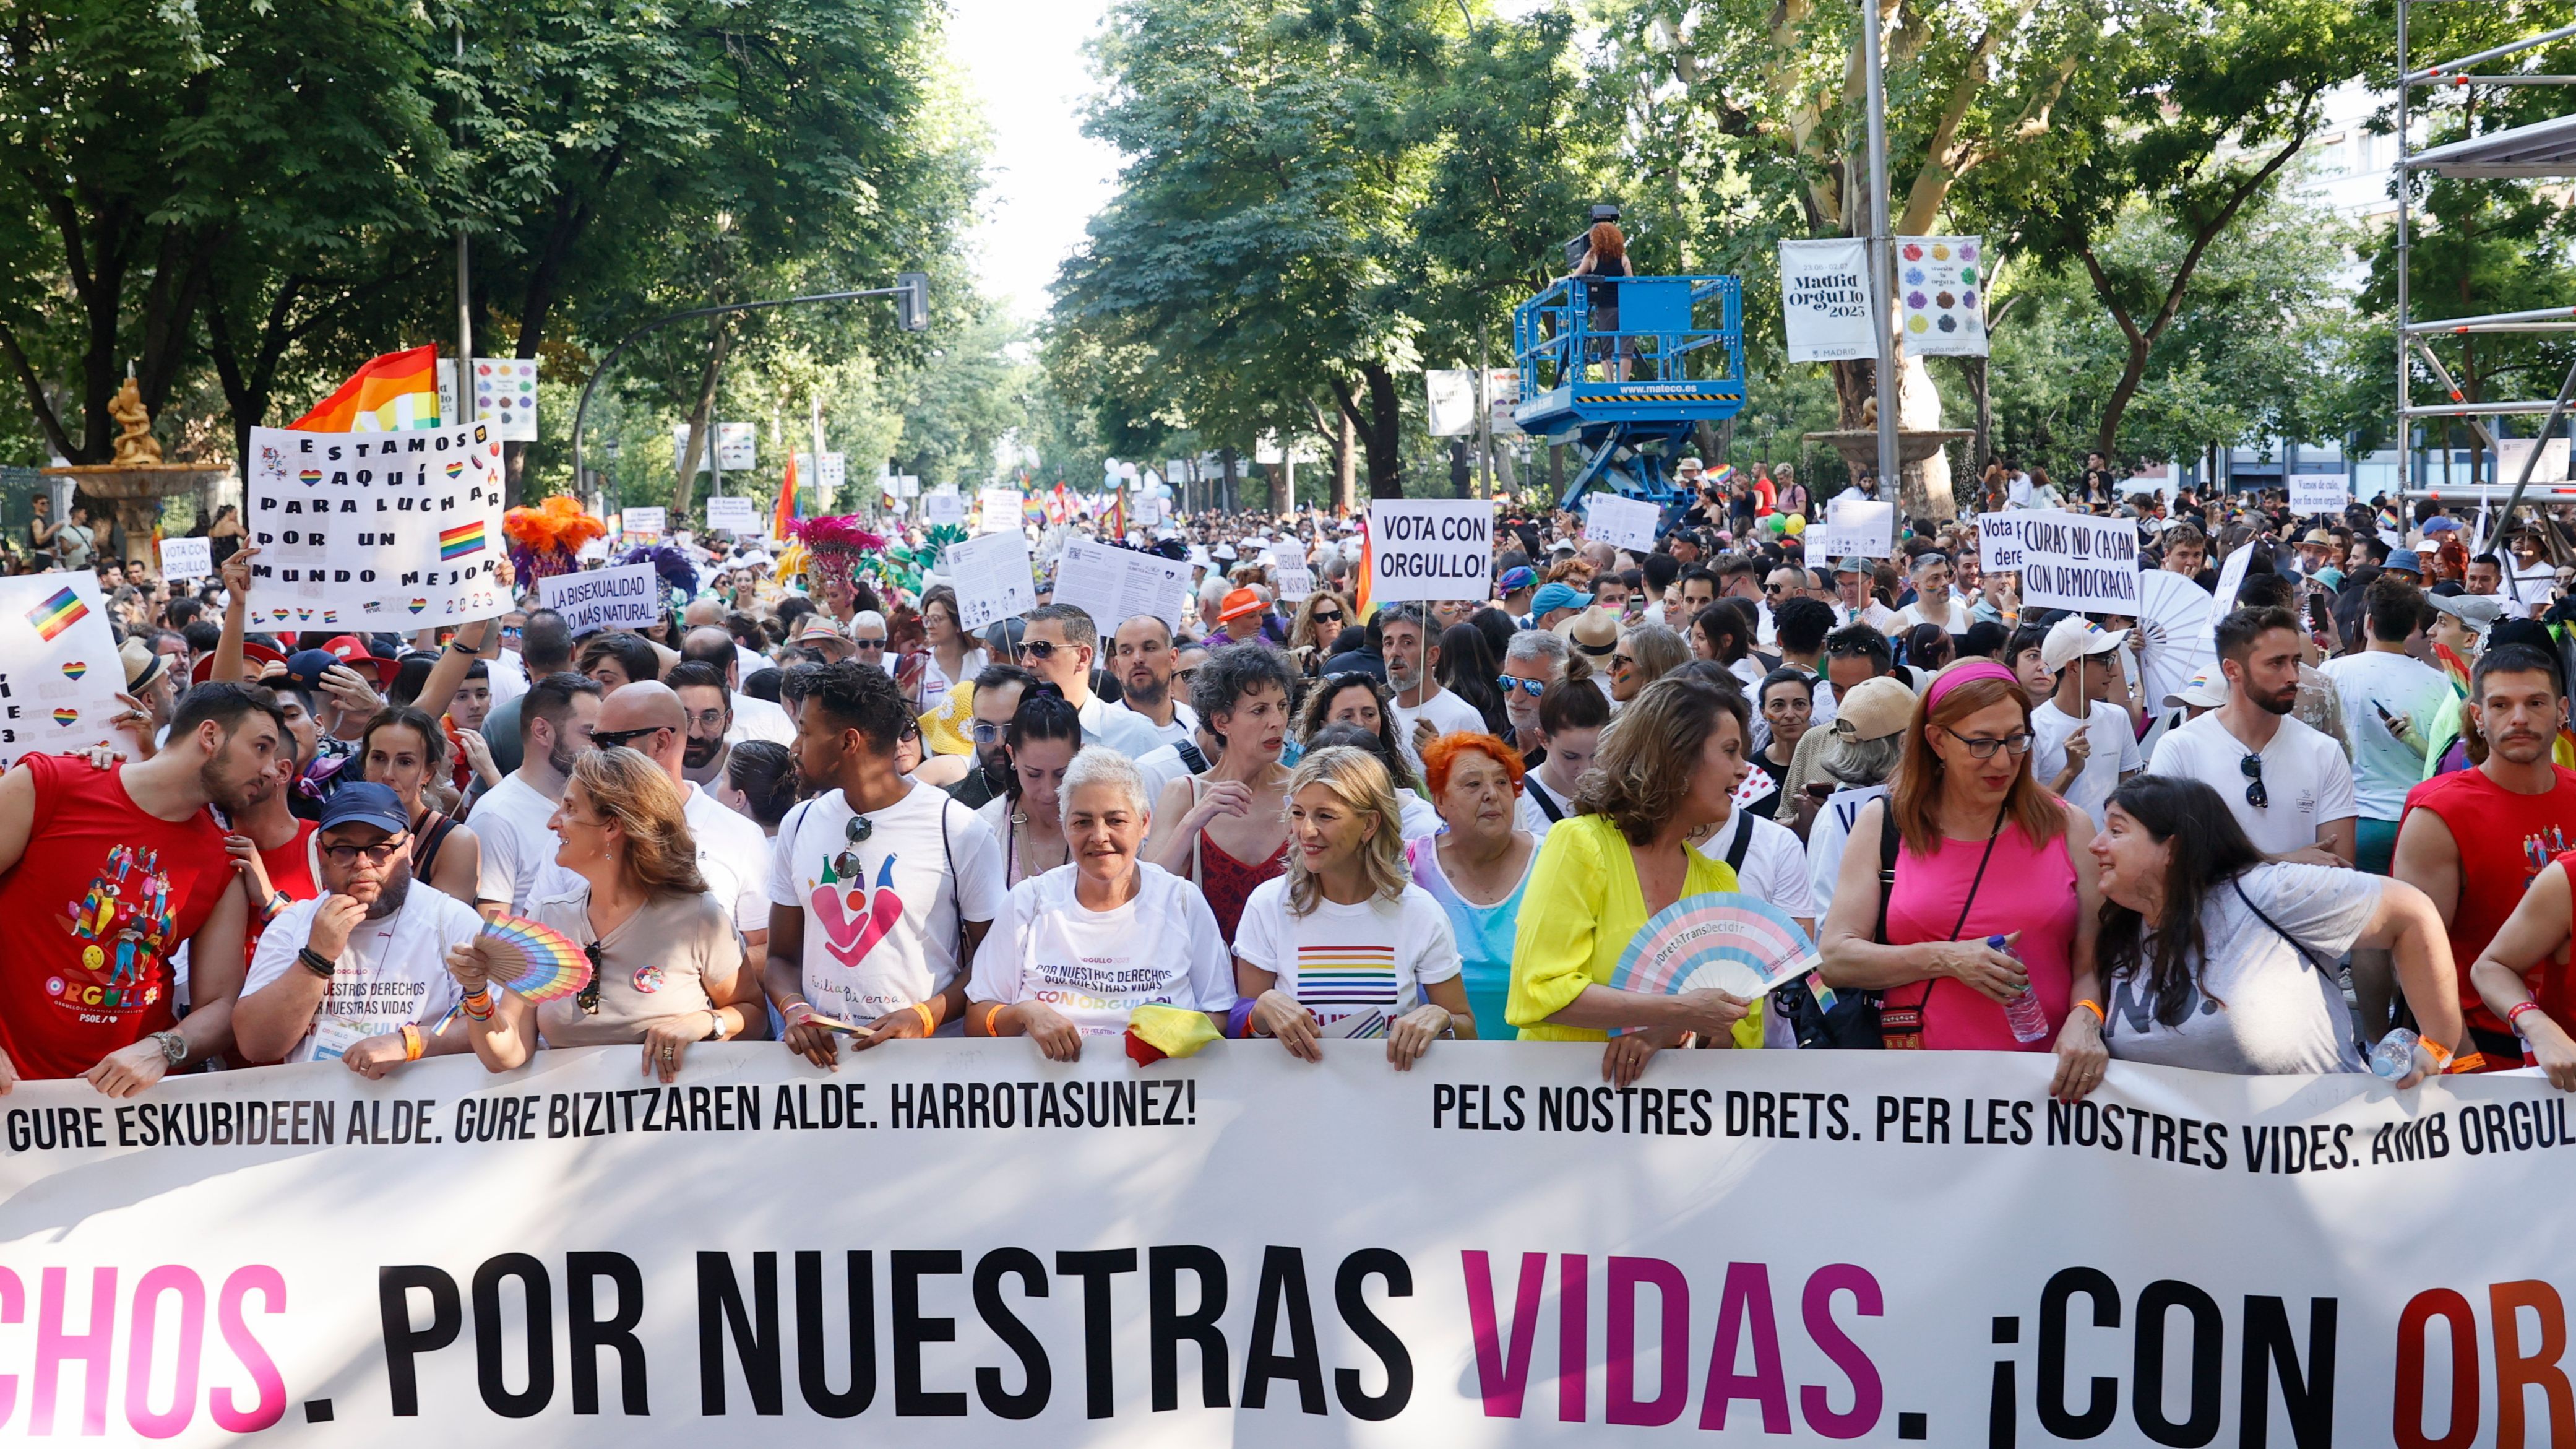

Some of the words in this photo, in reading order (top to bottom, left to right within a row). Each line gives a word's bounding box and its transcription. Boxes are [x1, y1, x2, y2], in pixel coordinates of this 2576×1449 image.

[1794, 274, 1858, 290] Madrid
[1829, 306, 1865, 318] 2023
[1823, 348, 1856, 357] MADRID
[1920, 346, 1974, 355] orgullo.madrid.es
[1619, 384, 1697, 394] www.mateco.es
[300, 433, 466, 461] ESTAMOS
[331, 464, 426, 487] AQUÍ
[2298, 479, 2317, 489] Vamos
[2318, 480, 2324, 489] de
[260, 497, 358, 514] PARA
[376, 486, 499, 512] LUCHAR
[2293, 498, 2302, 508] por
[2324, 495, 2345, 508] orgullo.
[257, 530, 325, 547] POR
[358, 532, 395, 546] UN
[1384, 516, 1436, 540] VOTA
[1442, 517, 1486, 541] CON
[1982, 519, 2012, 537] Vota
[164, 545, 186, 558] VOTA
[188, 544, 207, 555] CON
[2024, 521, 2067, 555] CURAS
[2073, 527, 2090, 555] NO
[2095, 530, 2134, 561] CASAN
[252, 564, 376, 582] MUNDO
[400, 560, 496, 586] MEJOR
[1380, 553, 1486, 577] ORGULLO!
[2027, 564, 2052, 594] CON
[446, 592, 494, 615] 2023
[552, 590, 567, 610] LA
[568, 576, 645, 605] BISEXUALIDAD
[579, 603, 600, 627] MÁS
[603, 603, 655, 621] NATURAL.
[1654, 921, 1745, 967] #DretATransDecidir
[1035, 964, 1058, 975] POR
[1059, 966, 1114, 983] NUESTROS
[1117, 969, 1173, 983] DERECHOS
[322, 982, 368, 997] UESTROS
[371, 982, 426, 997] DERECHOS
[54, 1000, 87, 1011] ORGULLOSA
[325, 1001, 378, 1015] NUESTRAS
[381, 1001, 414, 1014] VIDAS
[79, 1014, 101, 1023] PSOE
[7, 1107, 106, 1151] GURE
[116, 1100, 334, 1147] ESKUBIDEEN
[347, 1099, 442, 1144] ALDE.
[455, 1095, 540, 1143] GURE
[549, 1085, 760, 1139] BIZITZAREN
[773, 1084, 877, 1130] ALDE.
[892, 1079, 1195, 1129] HARROTASUNEZ!
[1433, 1084, 1525, 1131] PELS
[1538, 1086, 1712, 1136] NOSTRES
[1726, 1091, 1861, 1141] DRETS.
[1876, 1096, 1950, 1144] PER
[1965, 1099, 2033, 1145] LES
[2048, 1099, 2228, 1170] NOSTRES
[2242, 1123, 2359, 1174] VIDES.
[2372, 1112, 2449, 1165] AMB
[377, 1251, 650, 1419] POR
[696, 1245, 1414, 1421] NUESTRAS
[1462, 1250, 1927, 1441] VIDAS.
[1988, 1266, 2338, 1449] ¡CON
